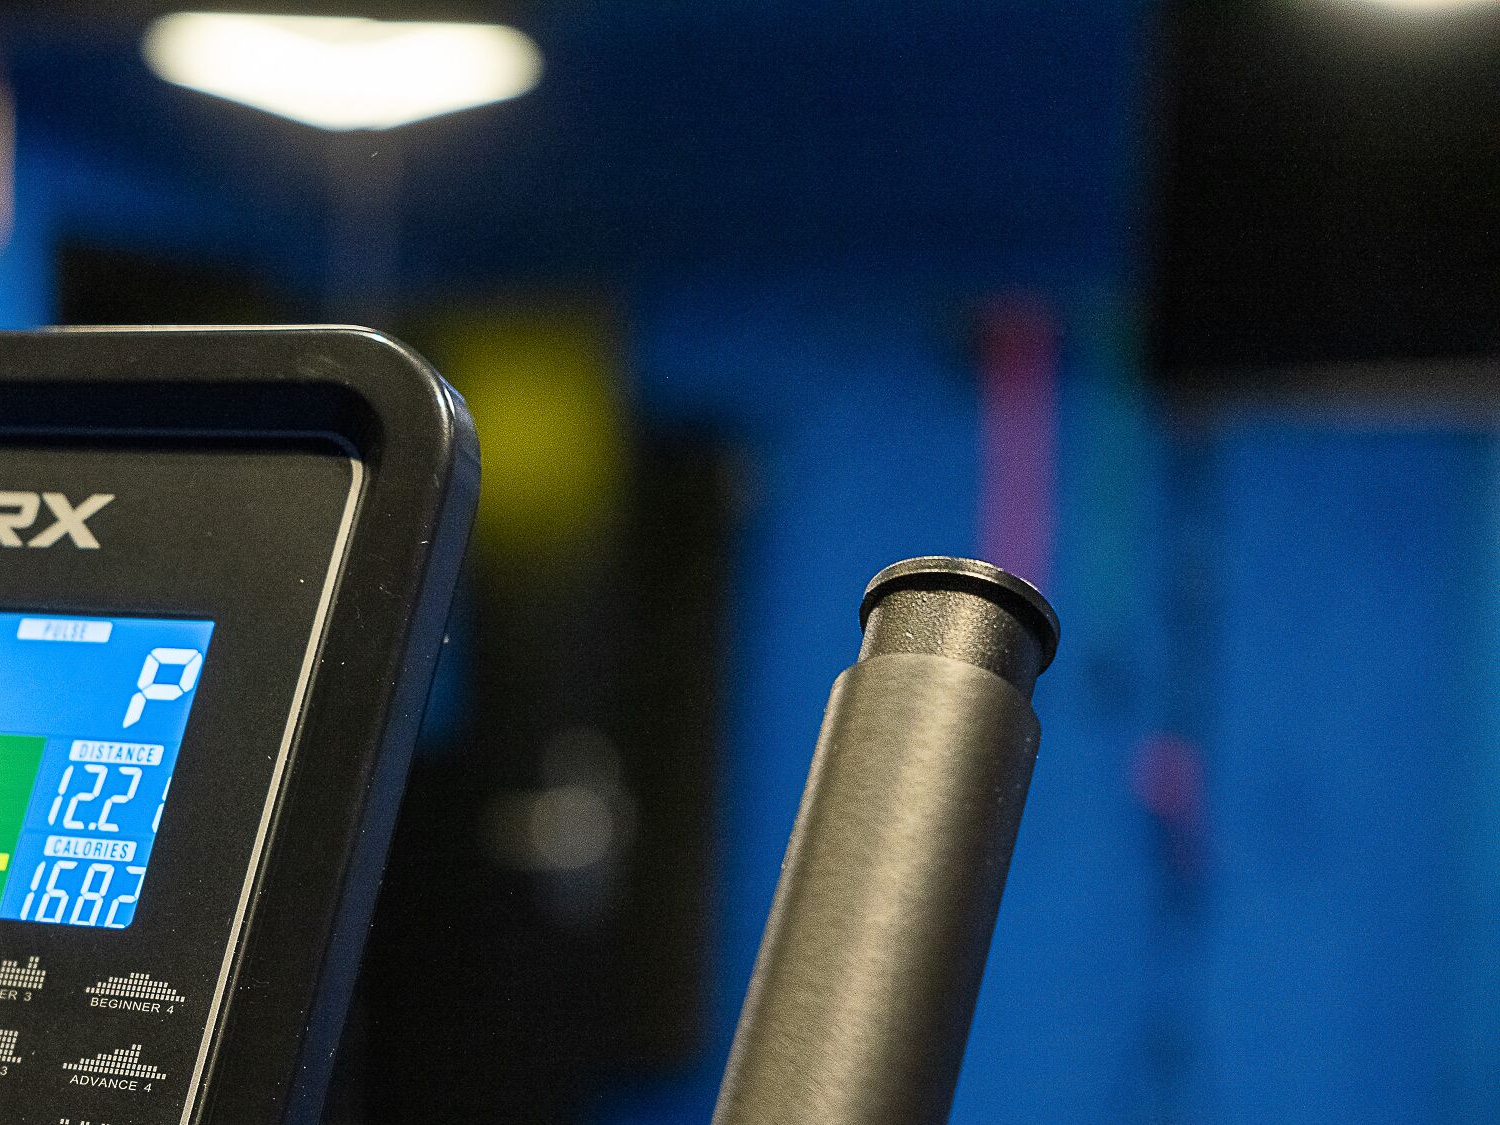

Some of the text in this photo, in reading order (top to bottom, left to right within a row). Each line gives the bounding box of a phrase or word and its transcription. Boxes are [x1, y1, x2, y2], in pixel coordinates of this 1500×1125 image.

[122, 647, 203, 729] P
[79, 743, 159, 763] DISTANCE
[53, 839, 130, 860] CALORIES
[19, 860, 147, 928] 1682
[23, 992, 33, 1003] 3
[90, 997, 175, 1015] BEGINNER 4
[0, 1065, 9, 1076] 3
[69, 1074, 153, 1093] ADVANCE 4
